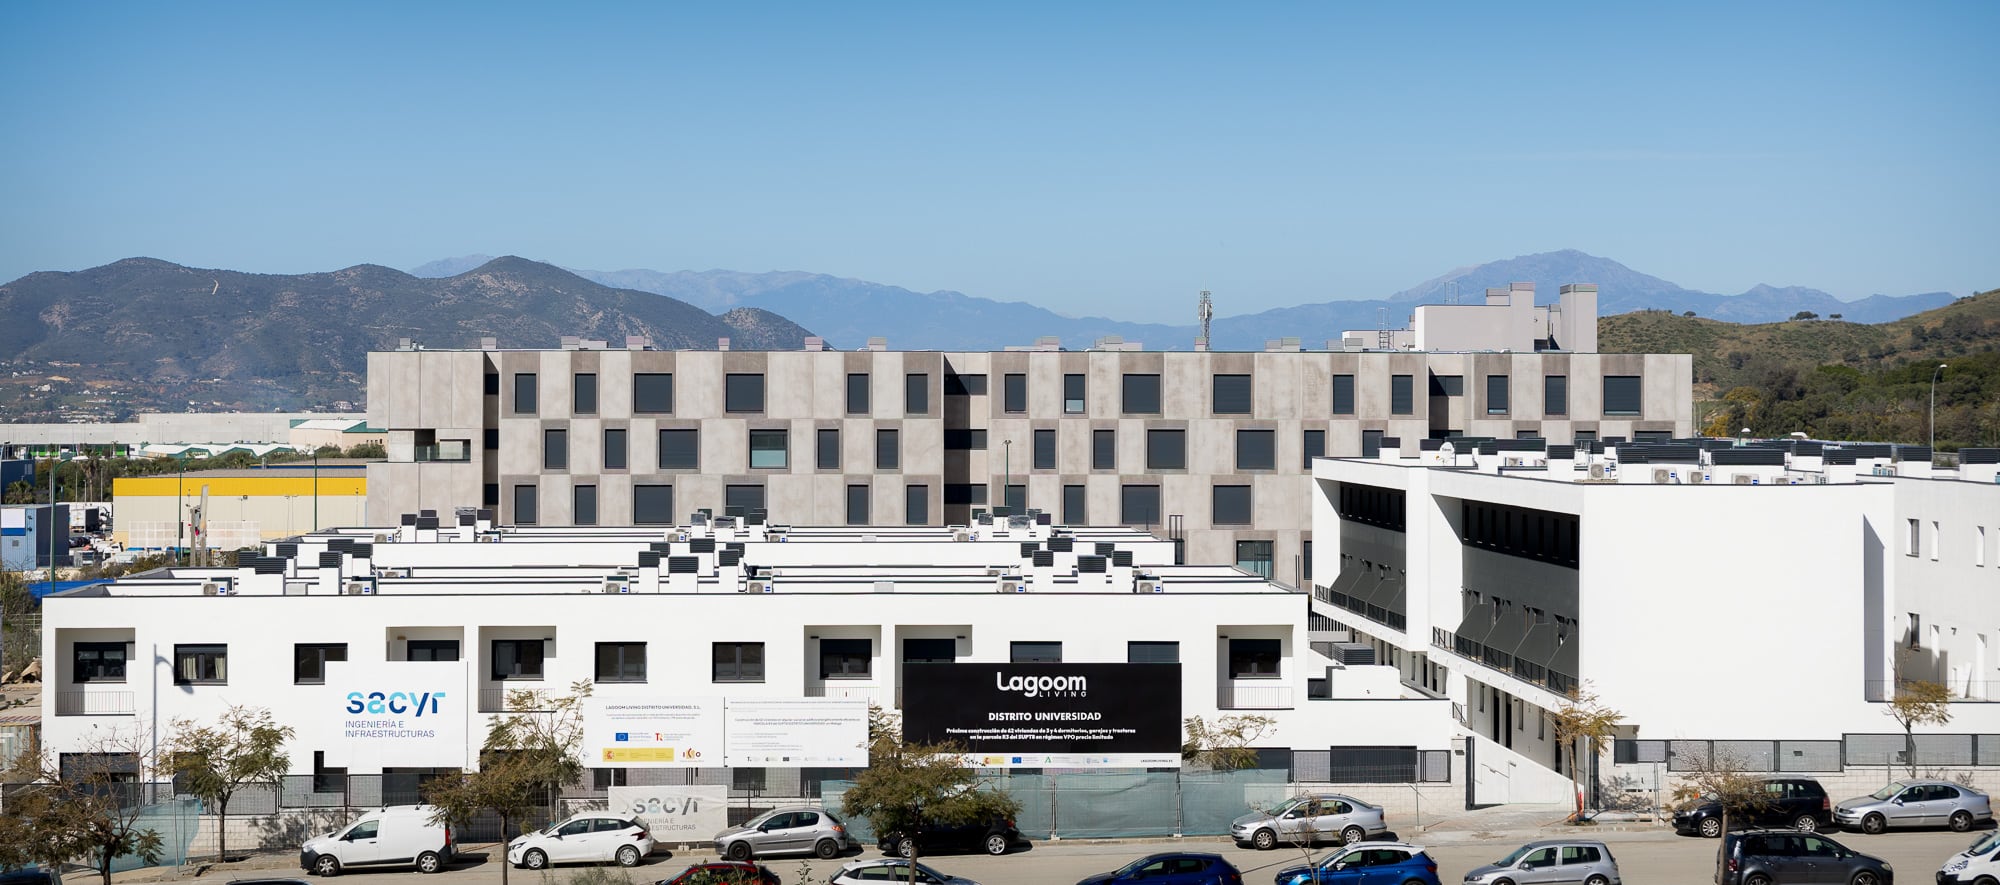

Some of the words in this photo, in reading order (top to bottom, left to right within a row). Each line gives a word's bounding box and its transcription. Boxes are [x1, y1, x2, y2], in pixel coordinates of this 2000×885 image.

[997, 671, 1087, 698] Lagoom
[346, 691, 446, 718] sacyr
[988, 712, 1032, 721] DISTRITO
[1035, 712, 1101, 721] UNIVERSIDAD
[345, 719, 397, 729] INGENIERÍA
[399, 721, 404, 729] E
[345, 730, 435, 738] INFRAESTRUCTURAS
[633, 798, 703, 816] sacyr
